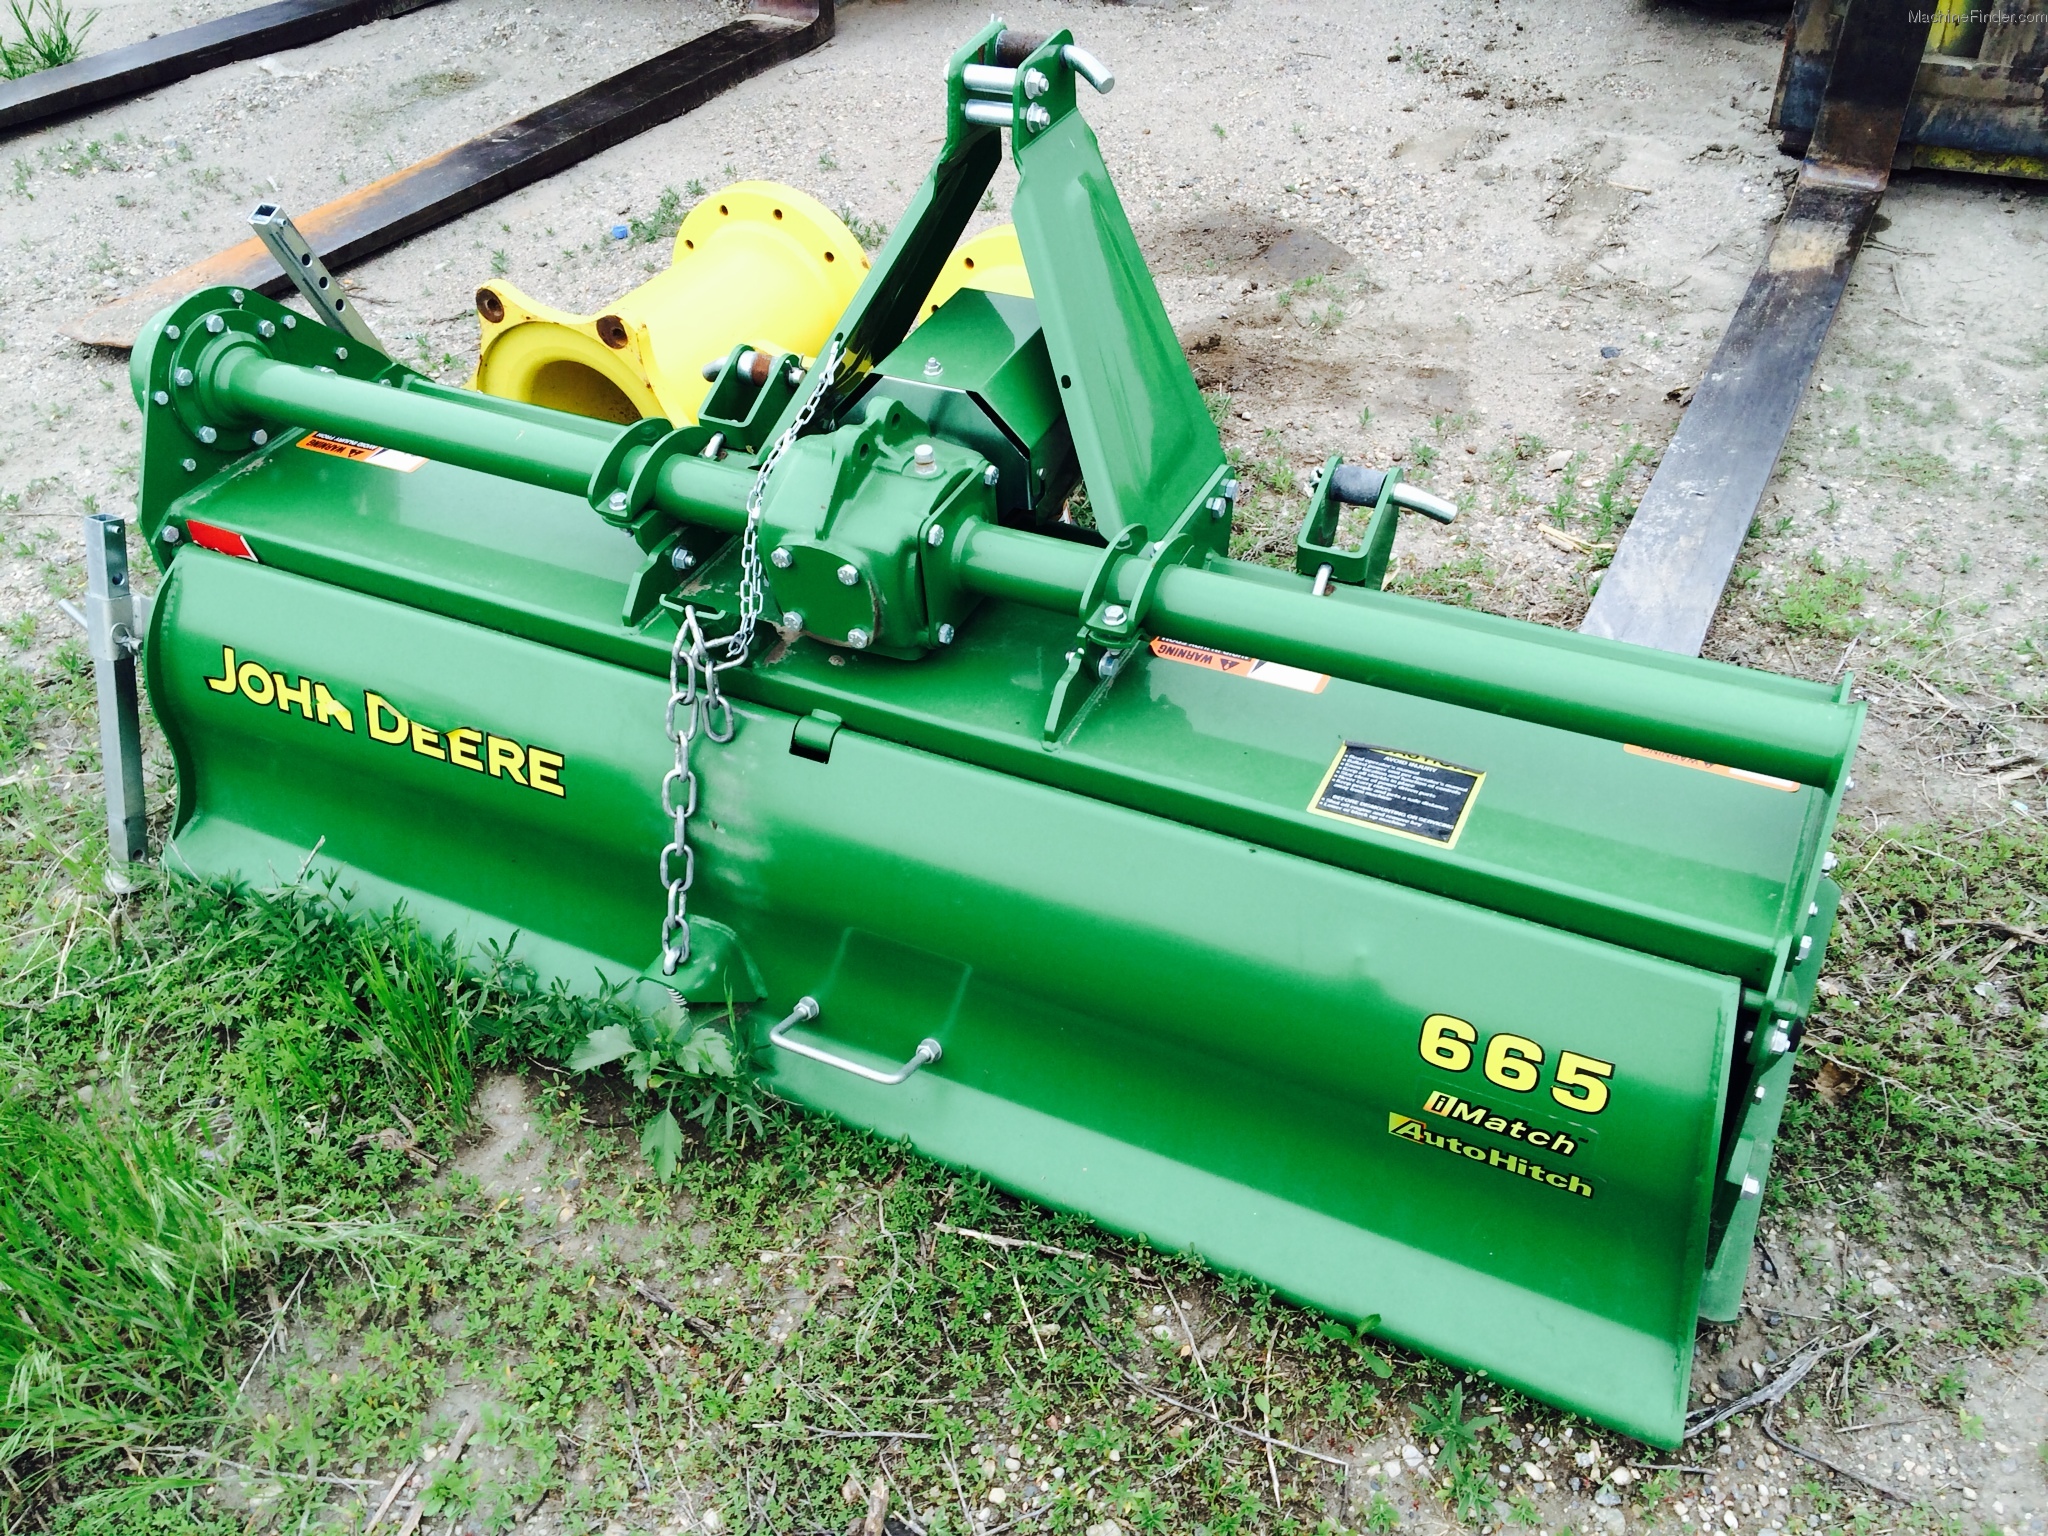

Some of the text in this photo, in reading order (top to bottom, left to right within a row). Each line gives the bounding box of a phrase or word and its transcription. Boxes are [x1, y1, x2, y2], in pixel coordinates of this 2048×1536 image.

[306, 439, 346, 454] WARNING
[1157, 643, 1213, 665] WARNING
[204, 645, 567, 799] JOHN DEERE
[1383, 756, 1408, 765] AVOID
[1408, 762, 1438, 772] INJURY
[1417, 1013, 1616, 1115] 665
[1388, 1112, 1594, 1199] AutoHitch
